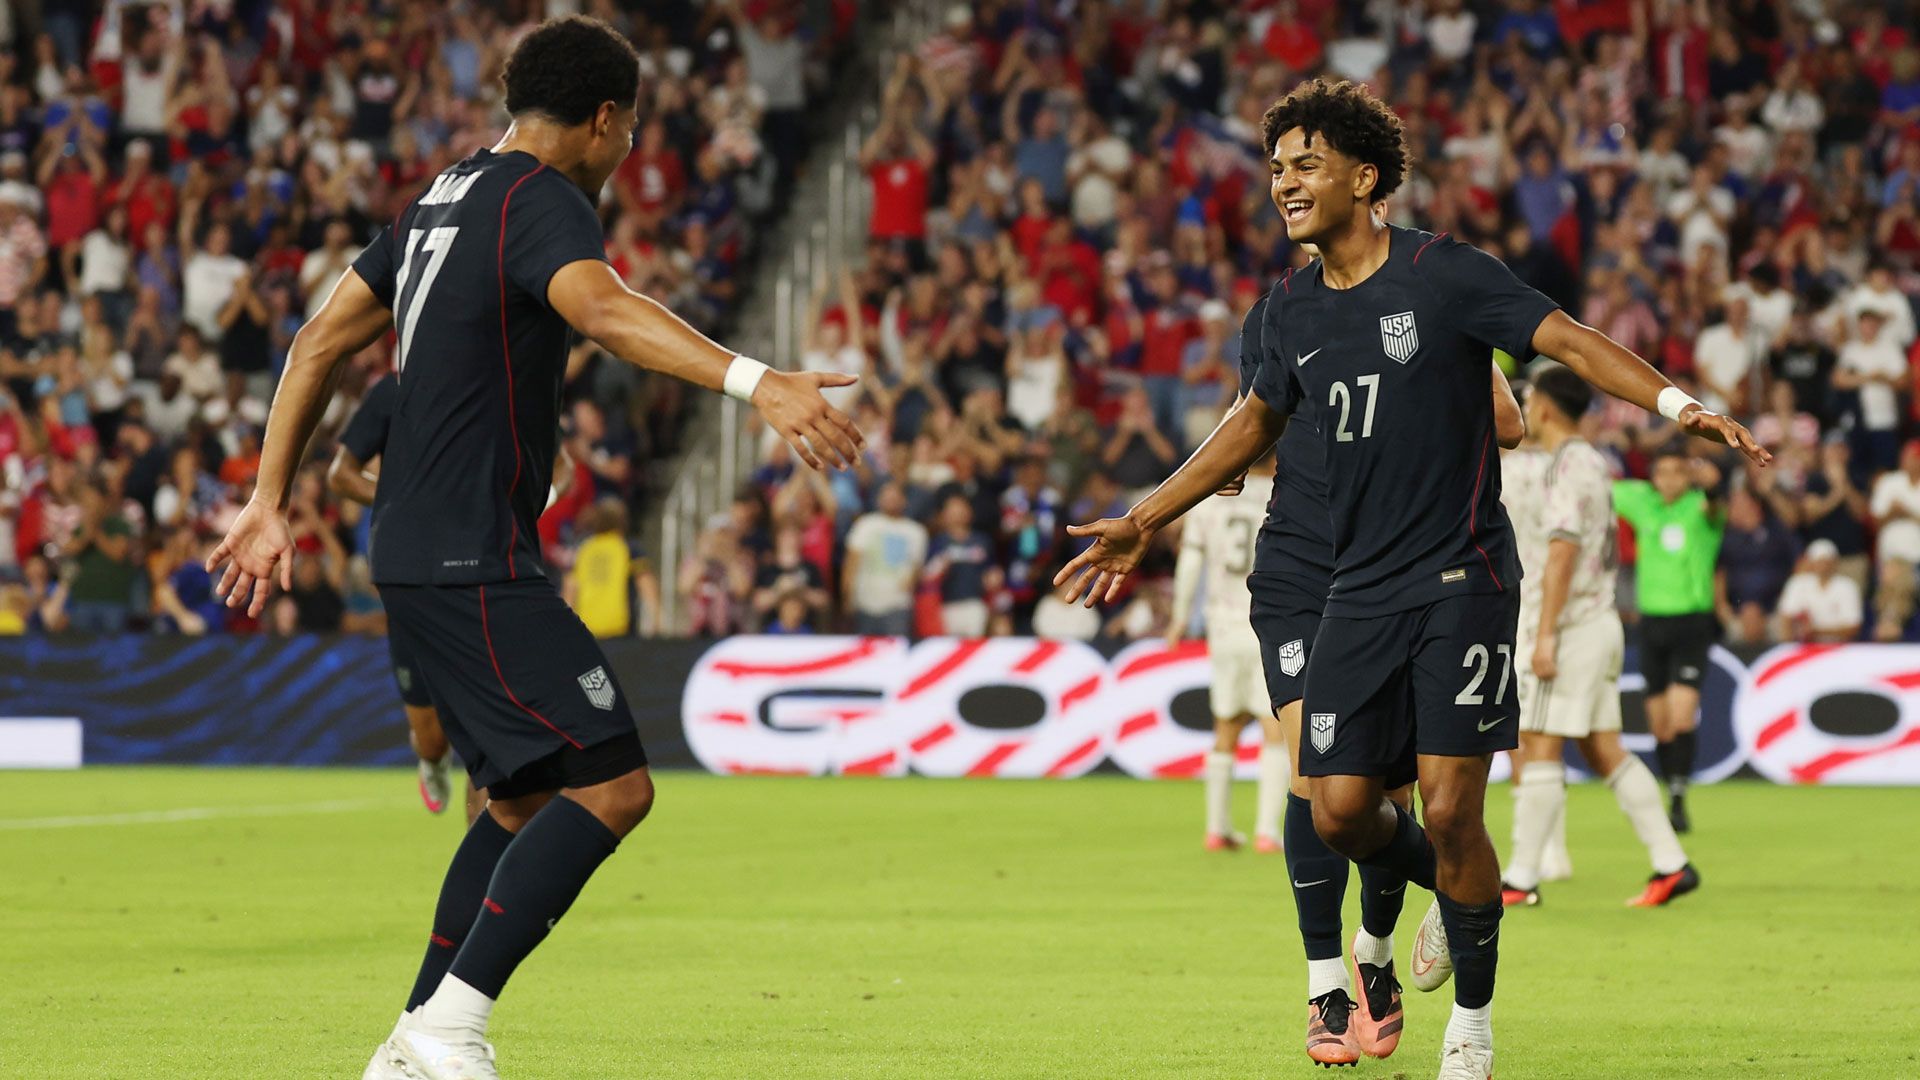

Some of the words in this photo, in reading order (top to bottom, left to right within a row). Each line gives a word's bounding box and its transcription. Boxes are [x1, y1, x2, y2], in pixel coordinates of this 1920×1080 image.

[393, 226, 460, 385] 17
[1383, 314, 1413, 336] USA
[1328, 373, 1381, 442] 27
[1225, 516, 1253, 575] 3
[1281, 641, 1302, 658] USA
[582, 670, 606, 689] USA
[1454, 643, 1512, 705] 27
[1312, 715, 1334, 731] USA
